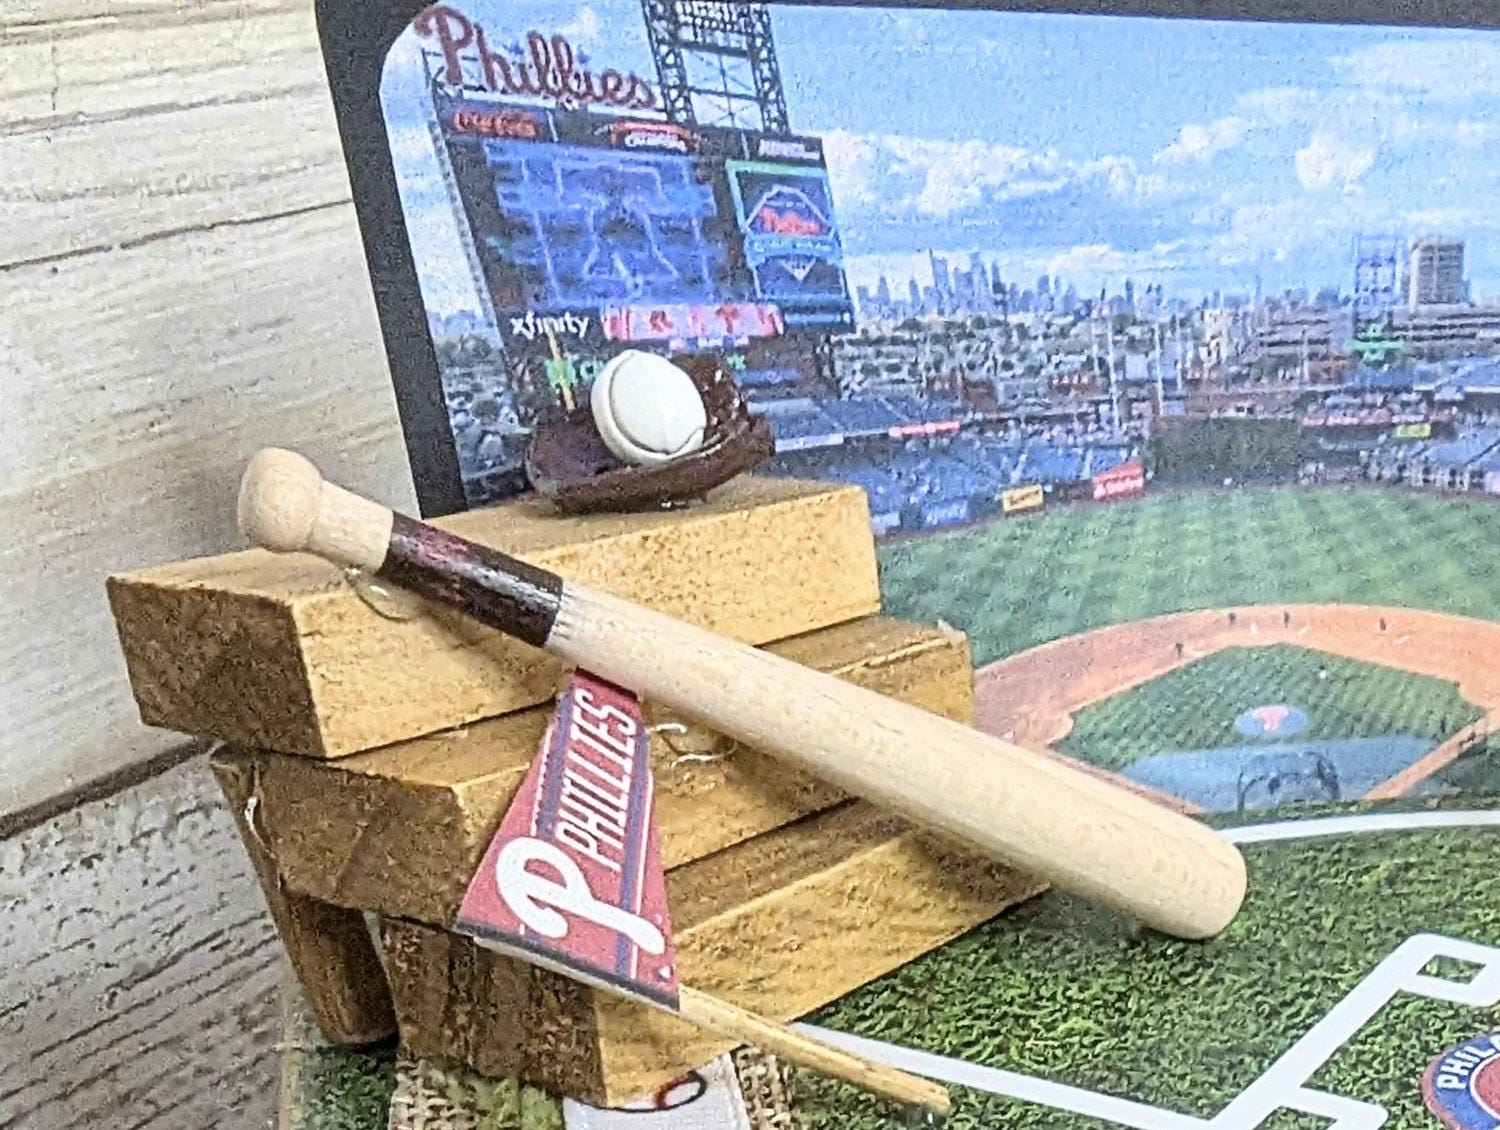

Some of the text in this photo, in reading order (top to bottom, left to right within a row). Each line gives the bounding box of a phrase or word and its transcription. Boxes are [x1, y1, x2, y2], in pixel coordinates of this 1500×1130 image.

[413, 5, 657, 108] Phillies
[510, 310, 591, 340] xfinity
[554, 687, 638, 873] PHILLIES
